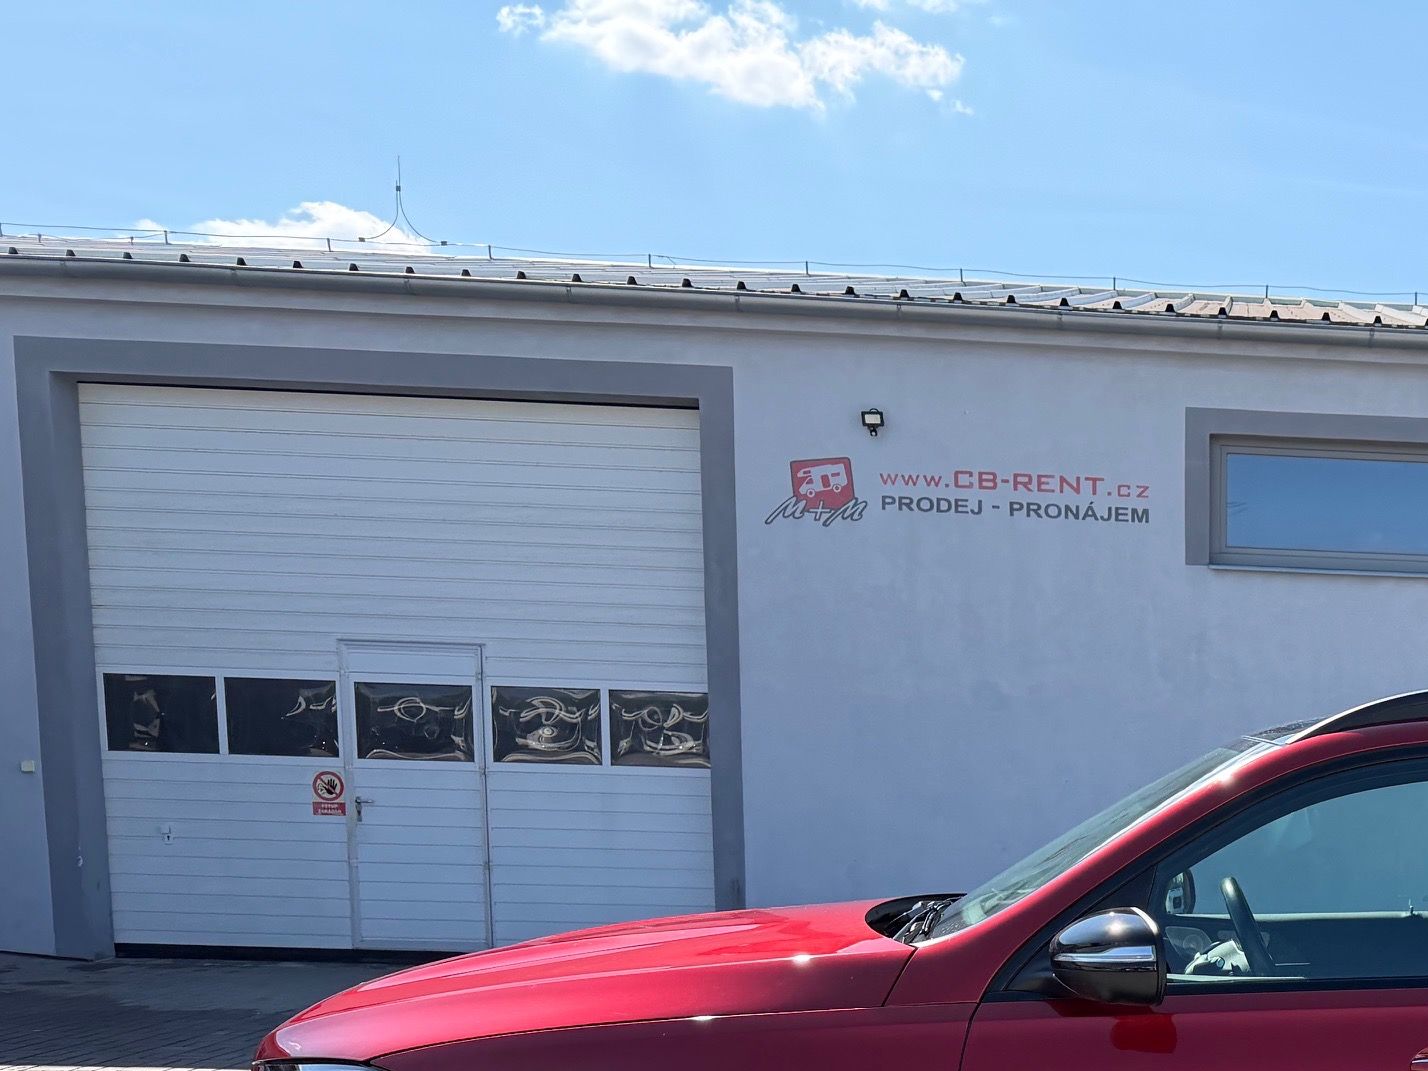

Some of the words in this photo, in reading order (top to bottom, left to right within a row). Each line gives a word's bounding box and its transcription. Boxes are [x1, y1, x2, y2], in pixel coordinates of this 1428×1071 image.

[879, 470, 1150, 499] www.CB-RENT.cz
[881, 495, 983, 516] PRODEJ
[1009, 501, 1150, 524] PRONÁJEM
